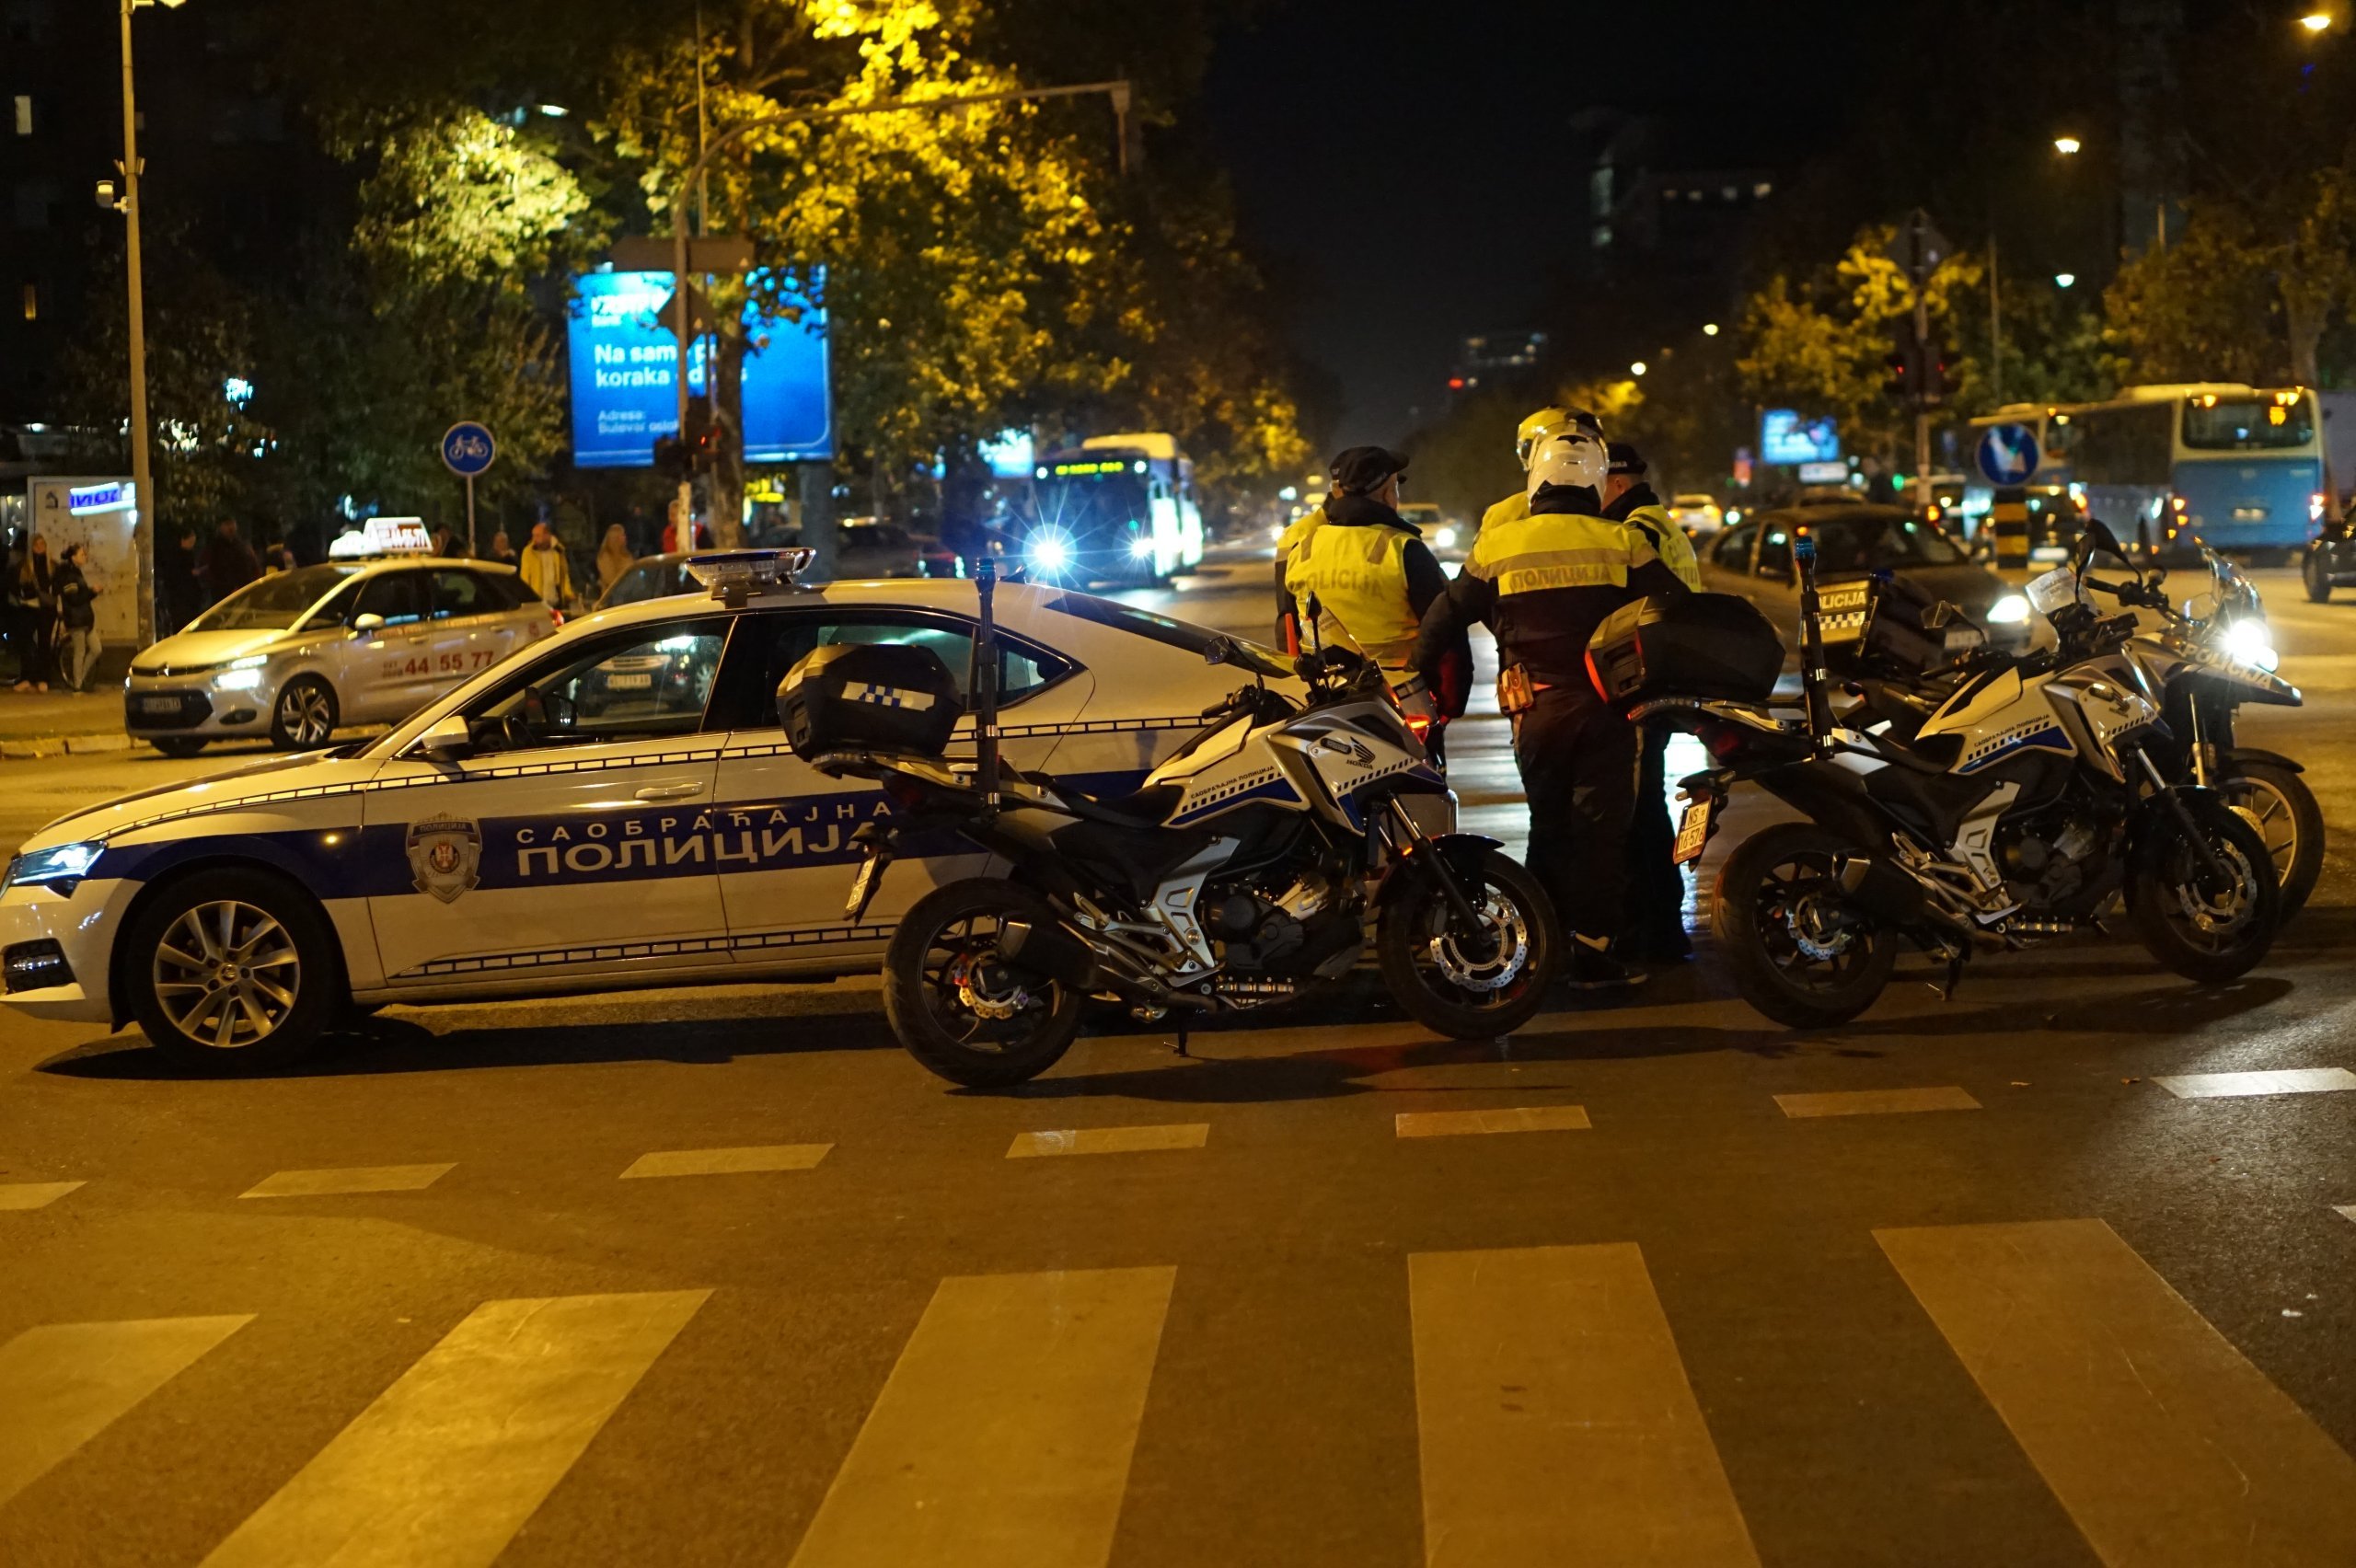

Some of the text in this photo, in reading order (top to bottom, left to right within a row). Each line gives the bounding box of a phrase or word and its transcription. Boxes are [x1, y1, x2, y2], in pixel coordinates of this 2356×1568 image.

[595, 343, 626, 363] Na
[596, 366, 671, 387] koraka
[405, 657, 430, 674] 44
[439, 651, 464, 672] 55
[470, 650, 495, 669] 77
[2181, 642, 2273, 690] POLICIJA
[1345, 758, 1374, 770] HONDA
[1190, 765, 1276, 800] САОБРАЋАЈНА ПОЛИЦИЈА
[420, 823, 468, 833] ПОЛИЦИЈА
[516, 801, 892, 844] САОБРАЋАЈНА
[1687, 808, 1700, 827] NS
